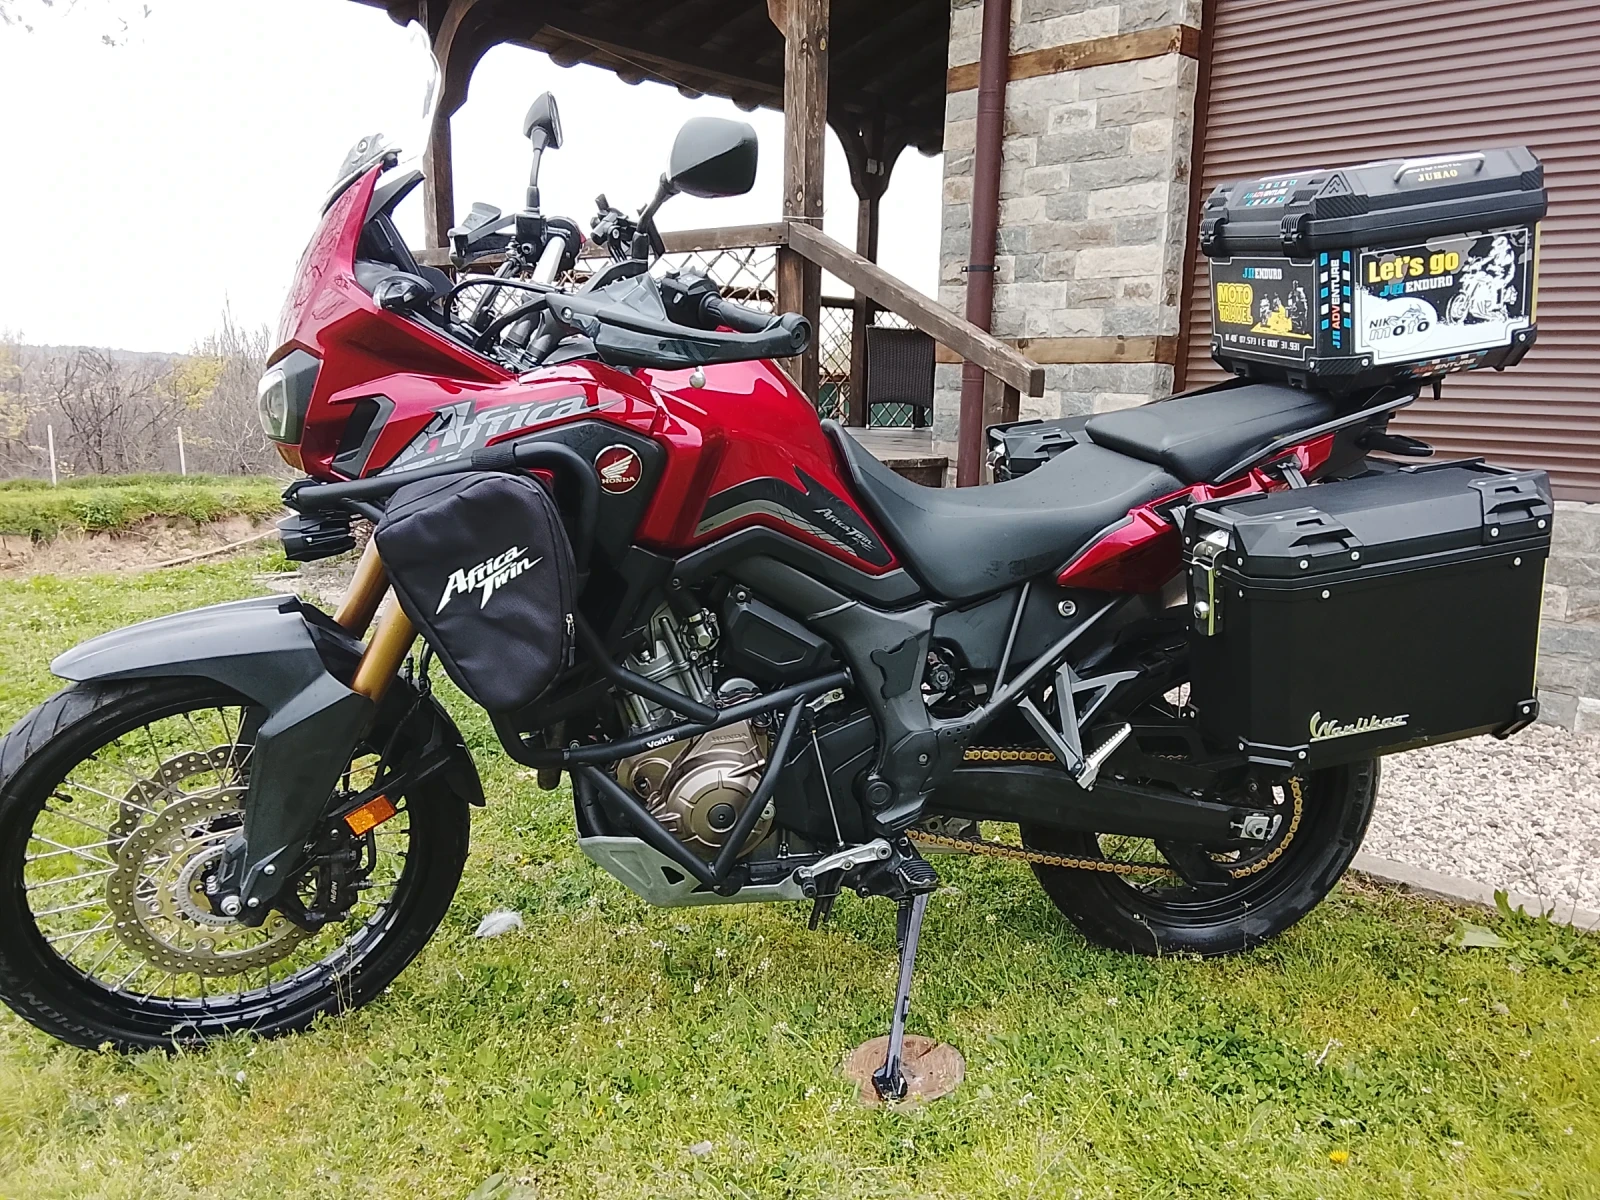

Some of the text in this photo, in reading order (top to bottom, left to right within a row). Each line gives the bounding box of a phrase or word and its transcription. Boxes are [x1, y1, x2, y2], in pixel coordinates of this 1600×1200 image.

[1417, 169, 1459, 182] JUHAO
[1368, 252, 1459, 283] Let's go
[1217, 283, 1253, 305] MOTO
[1330, 258, 1341, 330] ADVENTURE
[1405, 275, 1453, 293] ENDURO
[1218, 304, 1253, 325] TRAVEL
[1369, 317, 1390, 329] NIK
[1369, 321, 1430, 341] moto
[1412, 358, 1476, 374] ADVENTURE
[386, 396, 624, 471] Africa
[601, 476, 636, 484] HONDA
[435, 546, 529, 615] Africa
[474, 556, 544, 610] Twin
[710, 731, 749, 743] HONDA
